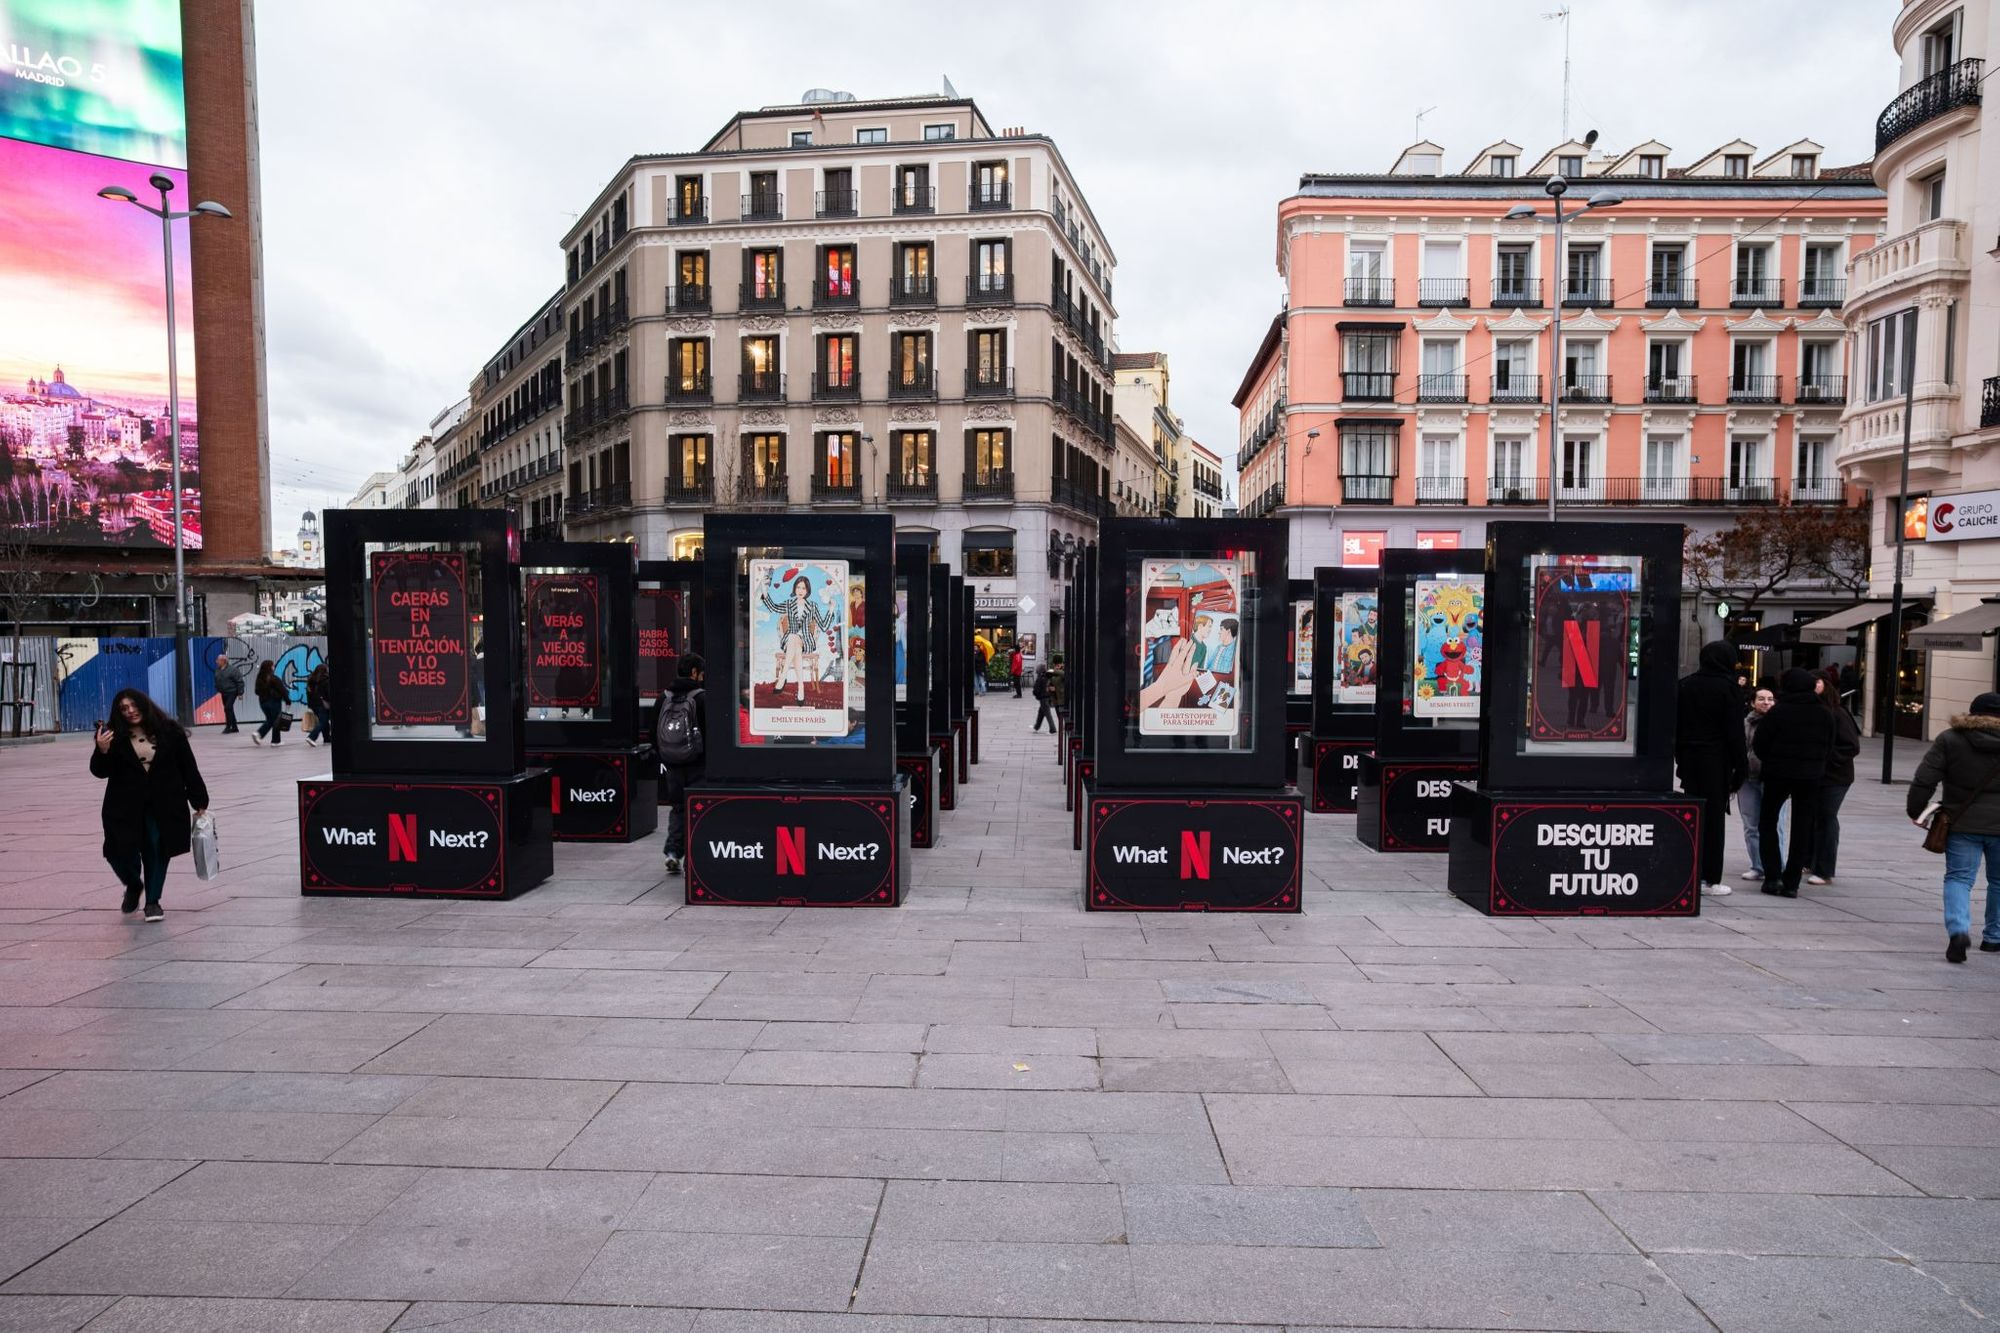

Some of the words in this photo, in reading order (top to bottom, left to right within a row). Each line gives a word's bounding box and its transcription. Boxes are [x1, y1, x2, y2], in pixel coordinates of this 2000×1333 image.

[0, 43, 82, 78] ALLAO
[89, 62, 106, 83] 5
[15, 67, 65, 88] MADRID
[1958, 503, 1993, 516] GRUPO
[1958, 515, 1998, 528] CALICHE
[391, 587, 449, 606] CAERÁS
[411, 608, 430, 622] EN
[544, 611, 584, 628] VERÁS
[411, 623, 430, 638] LA
[560, 629, 568, 640] A
[639, 627, 668, 638] HABRÁ
[379, 635, 464, 656] TENTACIÓN,
[543, 641, 586, 654] VIEJOS
[639, 639, 668, 648] CASOS
[536, 655, 592, 667] AMIGOS...
[1561, 620, 1600, 688] N
[407, 655, 417, 669] Y
[418, 655, 437, 669] LO
[399, 671, 446, 685] SABES
[794, 716, 804, 724] EN
[570, 788, 616, 802] Next?
[322, 827, 376, 846] What
[388, 813, 417, 862] N
[429, 830, 489, 848] Next?
[1537, 824, 1654, 846] DESCUBRE
[709, 841, 763, 859] What
[776, 826, 805, 875] N
[818, 842, 879, 860] Next?
[1113, 845, 1168, 863] What
[1180, 831, 1211, 880] N
[1223, 847, 1284, 864] Next?
[1580, 848, 1610, 870] TU
[1549, 873, 1639, 895] FUTURO
